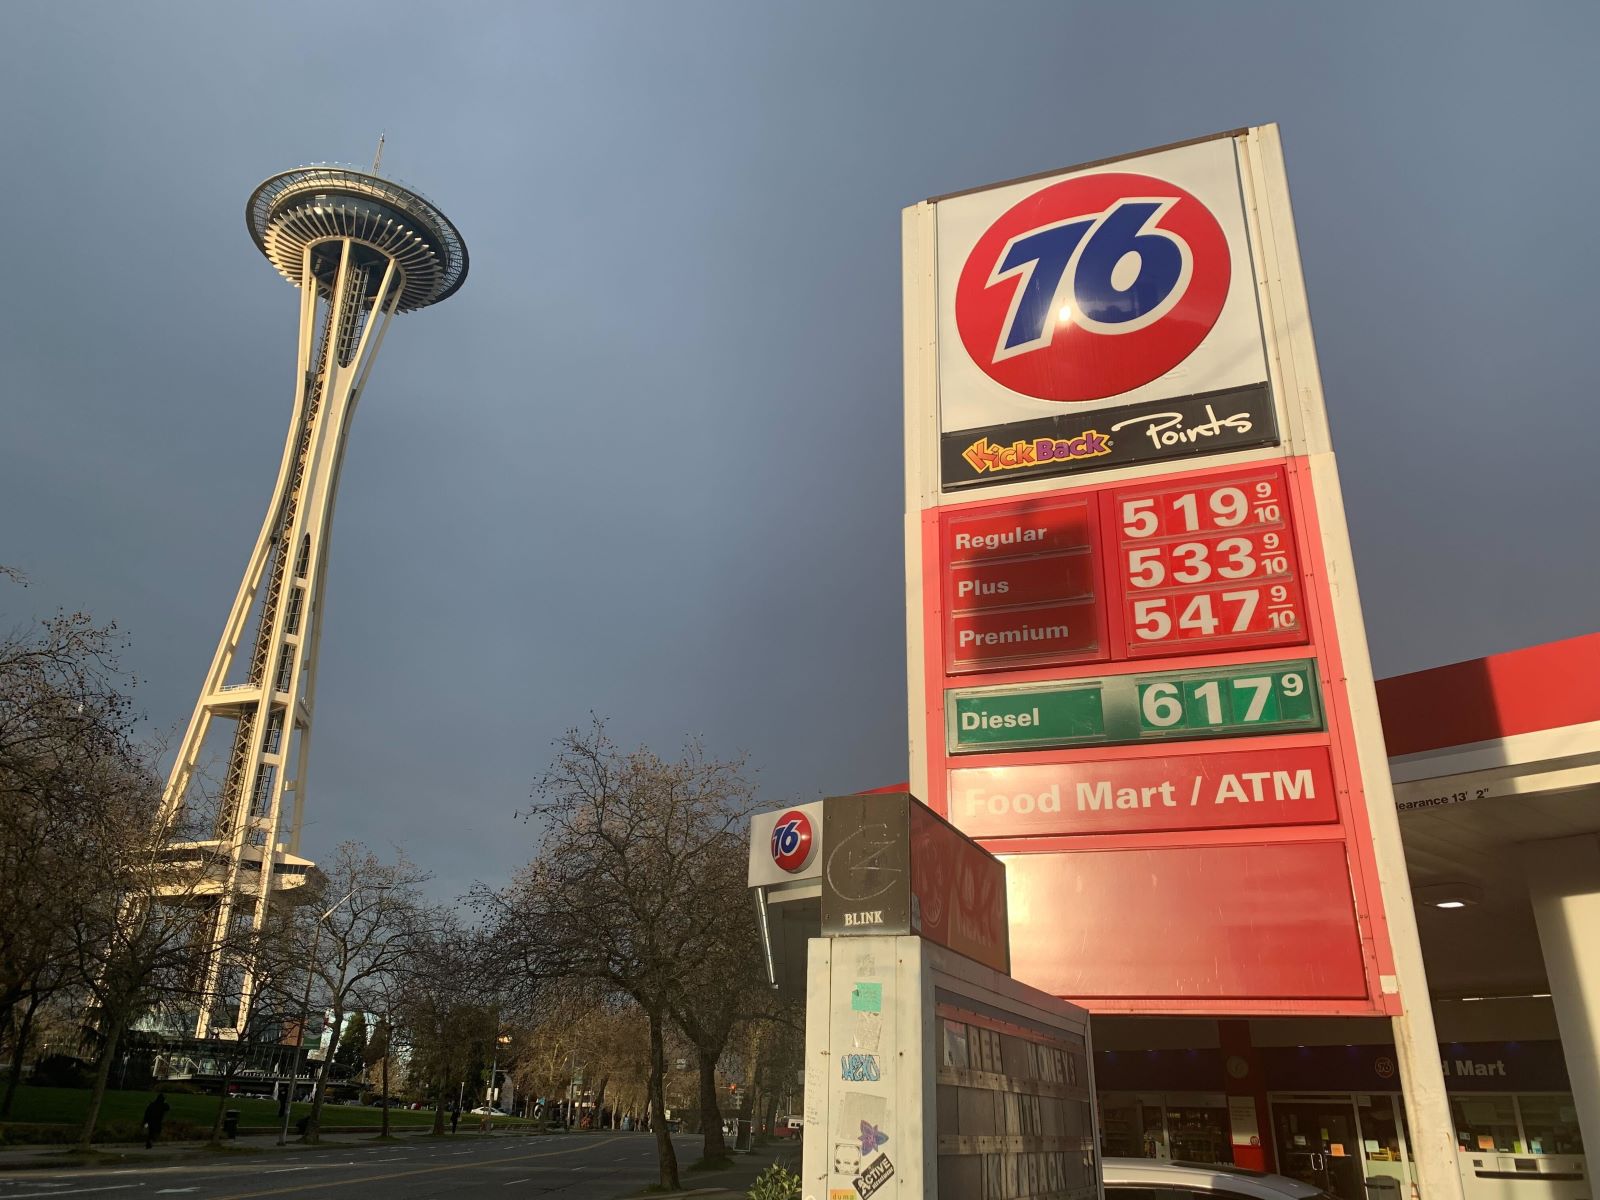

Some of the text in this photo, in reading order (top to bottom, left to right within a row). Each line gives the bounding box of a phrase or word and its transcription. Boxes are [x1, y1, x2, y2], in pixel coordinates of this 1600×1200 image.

[985, 197, 1193, 364] 76
[962, 404, 1253, 474] KickBack Points
[1122, 482, 1281, 538] 519 9 10
[955, 527, 1047, 550] Regular
[1129, 532, 1288, 588] 533 9 10
[958, 577, 1010, 597] Plus
[1134, 585, 1296, 640] 547 9 10
[959, 623, 1069, 648] Premium
[961, 708, 1040, 731] Diesel
[1142, 676, 1273, 727] 617
[964, 784, 1061, 817] Food
[1076, 781, 1177, 811] Mart
[1215, 769, 1315, 804] ATM
[1396, 795, 1449, 810] learance
[771, 821, 801, 859] 76
[844, 910, 884, 927] BLINK
[1455, 1060, 1507, 1077] Mart
[857, 1158, 891, 1195] ACTIVE
